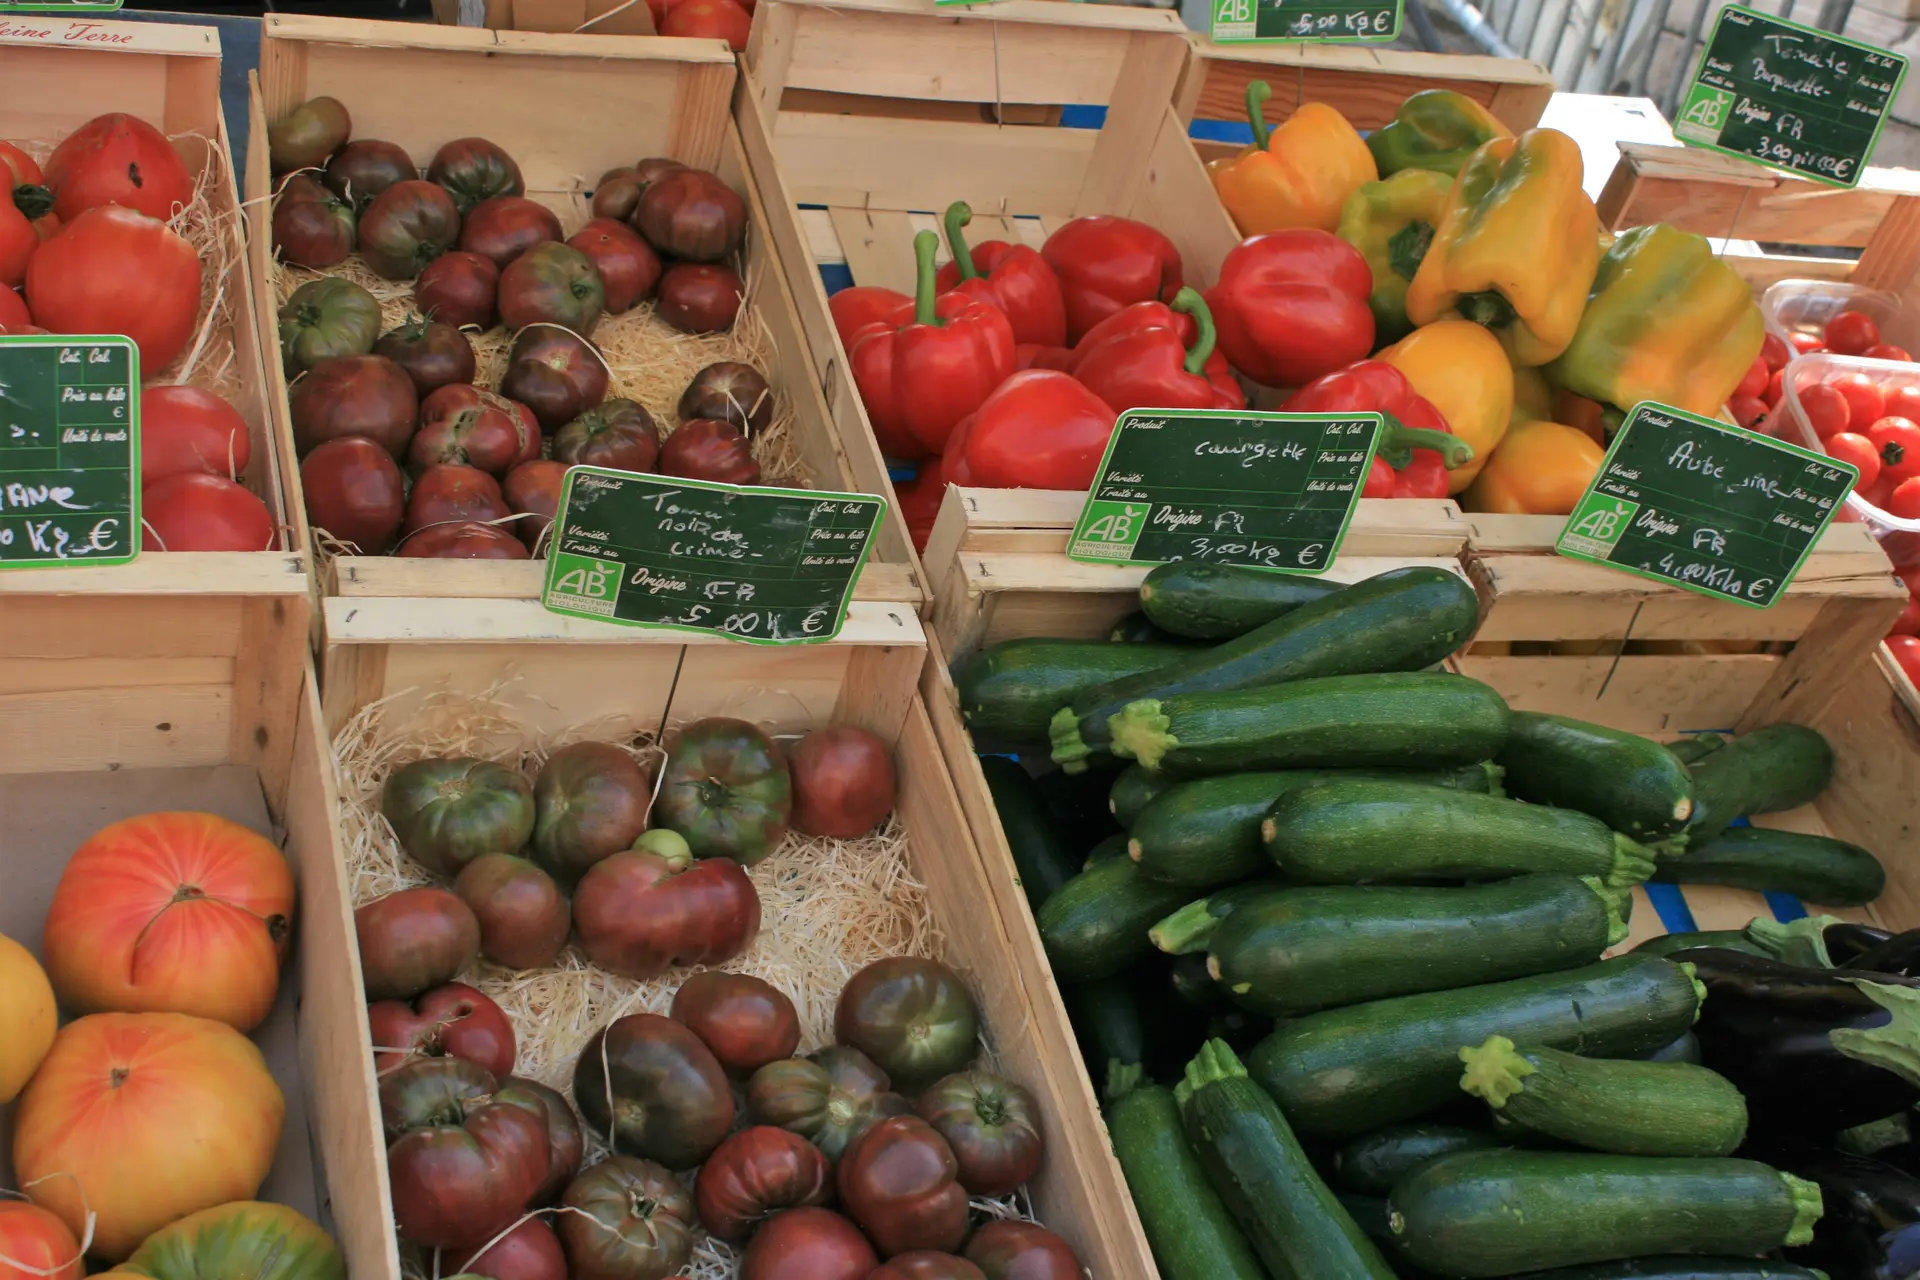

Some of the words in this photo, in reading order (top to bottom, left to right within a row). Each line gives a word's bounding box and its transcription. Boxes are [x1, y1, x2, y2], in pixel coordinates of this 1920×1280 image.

[1218, 0, 1250, 21] AB
[1373, 10, 1391, 32] €
[64, 22, 133, 43] Terre
[1686, 99, 1720, 126] AB
[1775, 113, 1804, 140] FR
[1833, 158, 1855, 178] €
[61, 387, 87, 402] Prix
[112, 406, 124, 418] €
[1637, 410, 1674, 428] Produit
[1125, 418, 1166, 429] Produit
[576, 475, 623, 490] Produit
[1107, 471, 1145, 483] Variété
[1099, 487, 1134, 498] Traité
[1082, 515, 1132, 542] AB
[1153, 505, 1203, 531] Origine
[1572, 509, 1619, 539] AB
[88, 518, 119, 550] €
[568, 525, 610, 541] Variété
[1636, 509, 1679, 537] Origine
[1693, 528, 1727, 556] FR
[564, 540, 600, 555] Traité
[603, 550, 619, 558] au
[1075, 541, 1134, 551] AGRICULTURE
[1298, 543, 1323, 565] €
[554, 569, 607, 598] AB
[630, 567, 687, 594] Origine
[1747, 578, 1773, 598] €
[548, 592, 614, 608] AGRICULTURE
[801, 610, 828, 634] €
